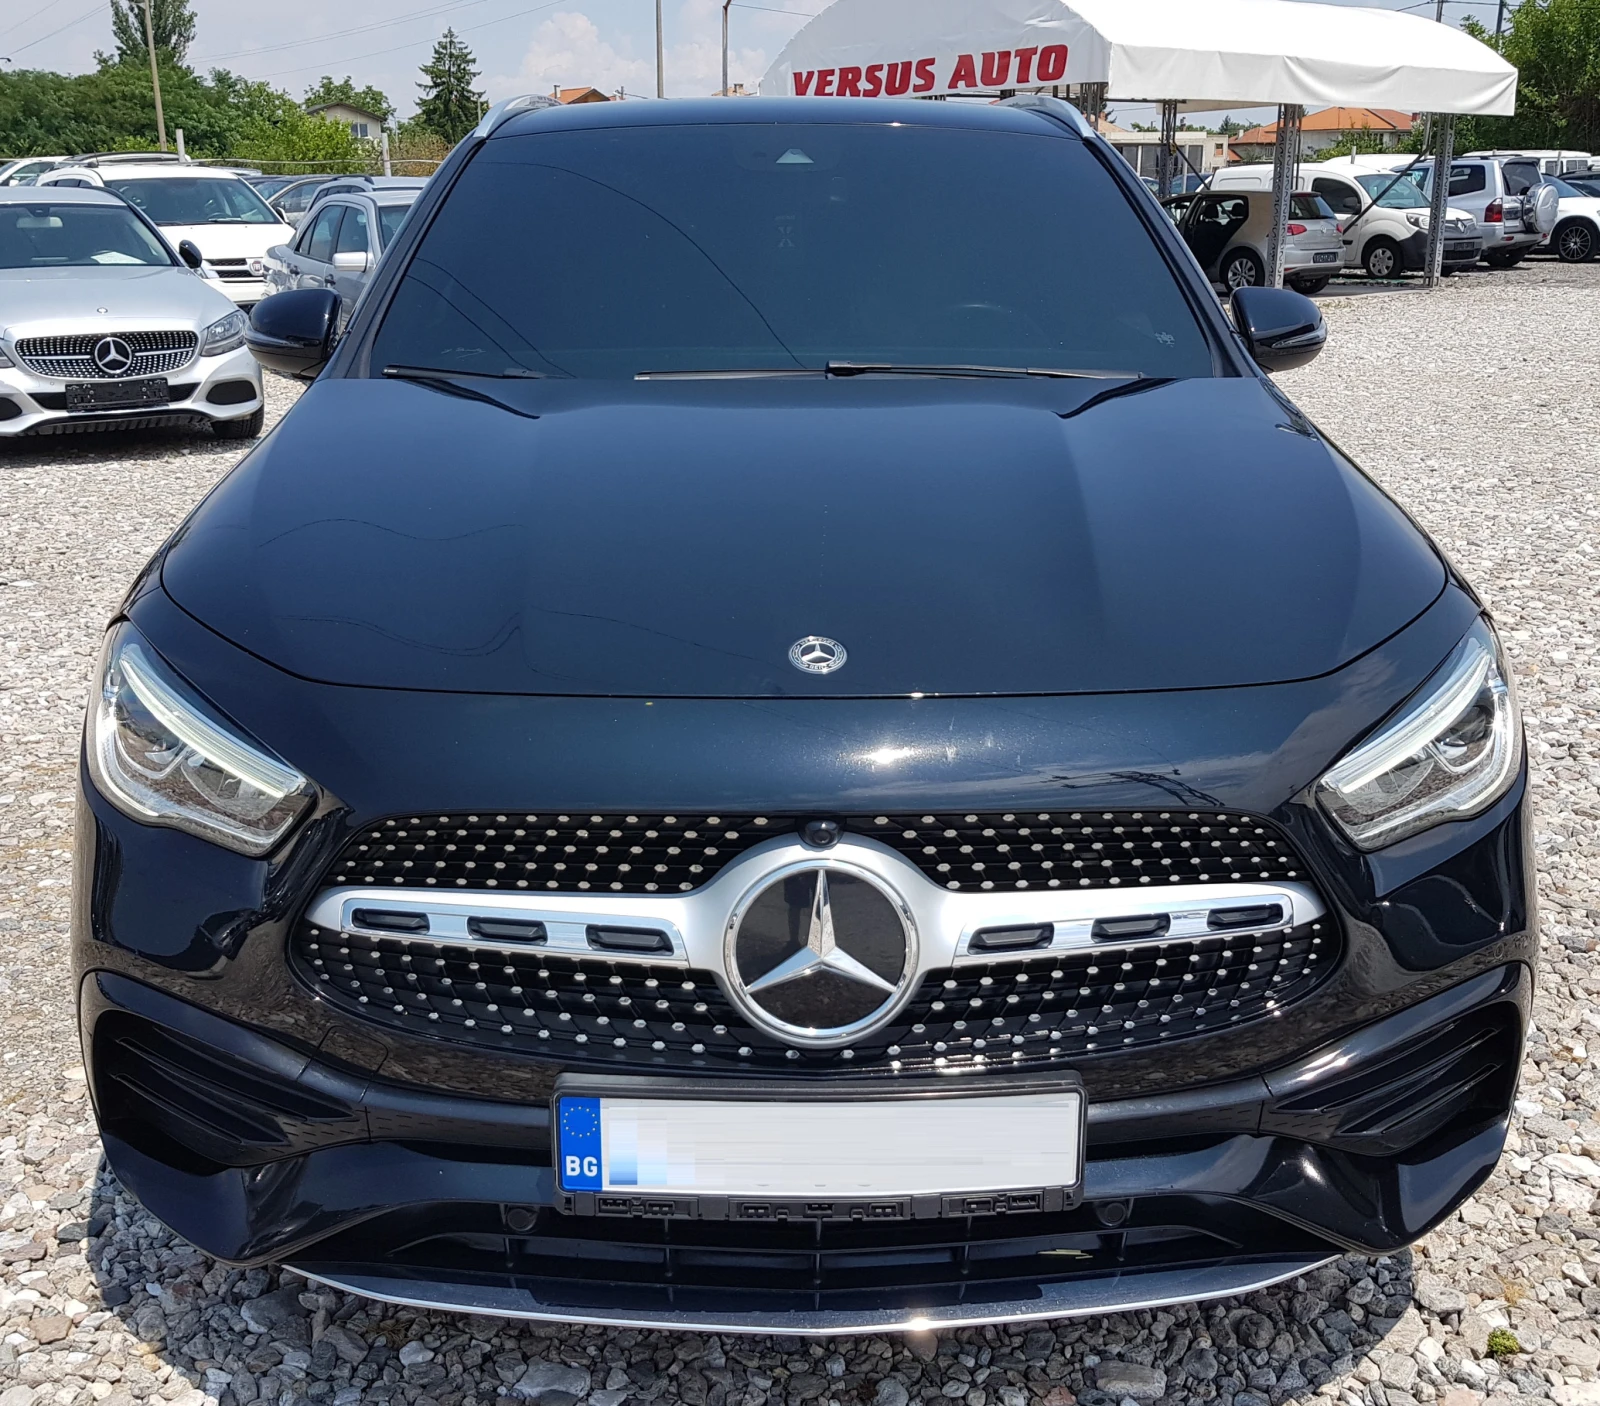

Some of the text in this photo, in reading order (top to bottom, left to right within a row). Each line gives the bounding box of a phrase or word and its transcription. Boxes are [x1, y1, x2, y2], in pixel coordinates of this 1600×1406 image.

[793, 44, 1068, 97] VERSUS AUTO
[565, 1155, 598, 1177] BG
